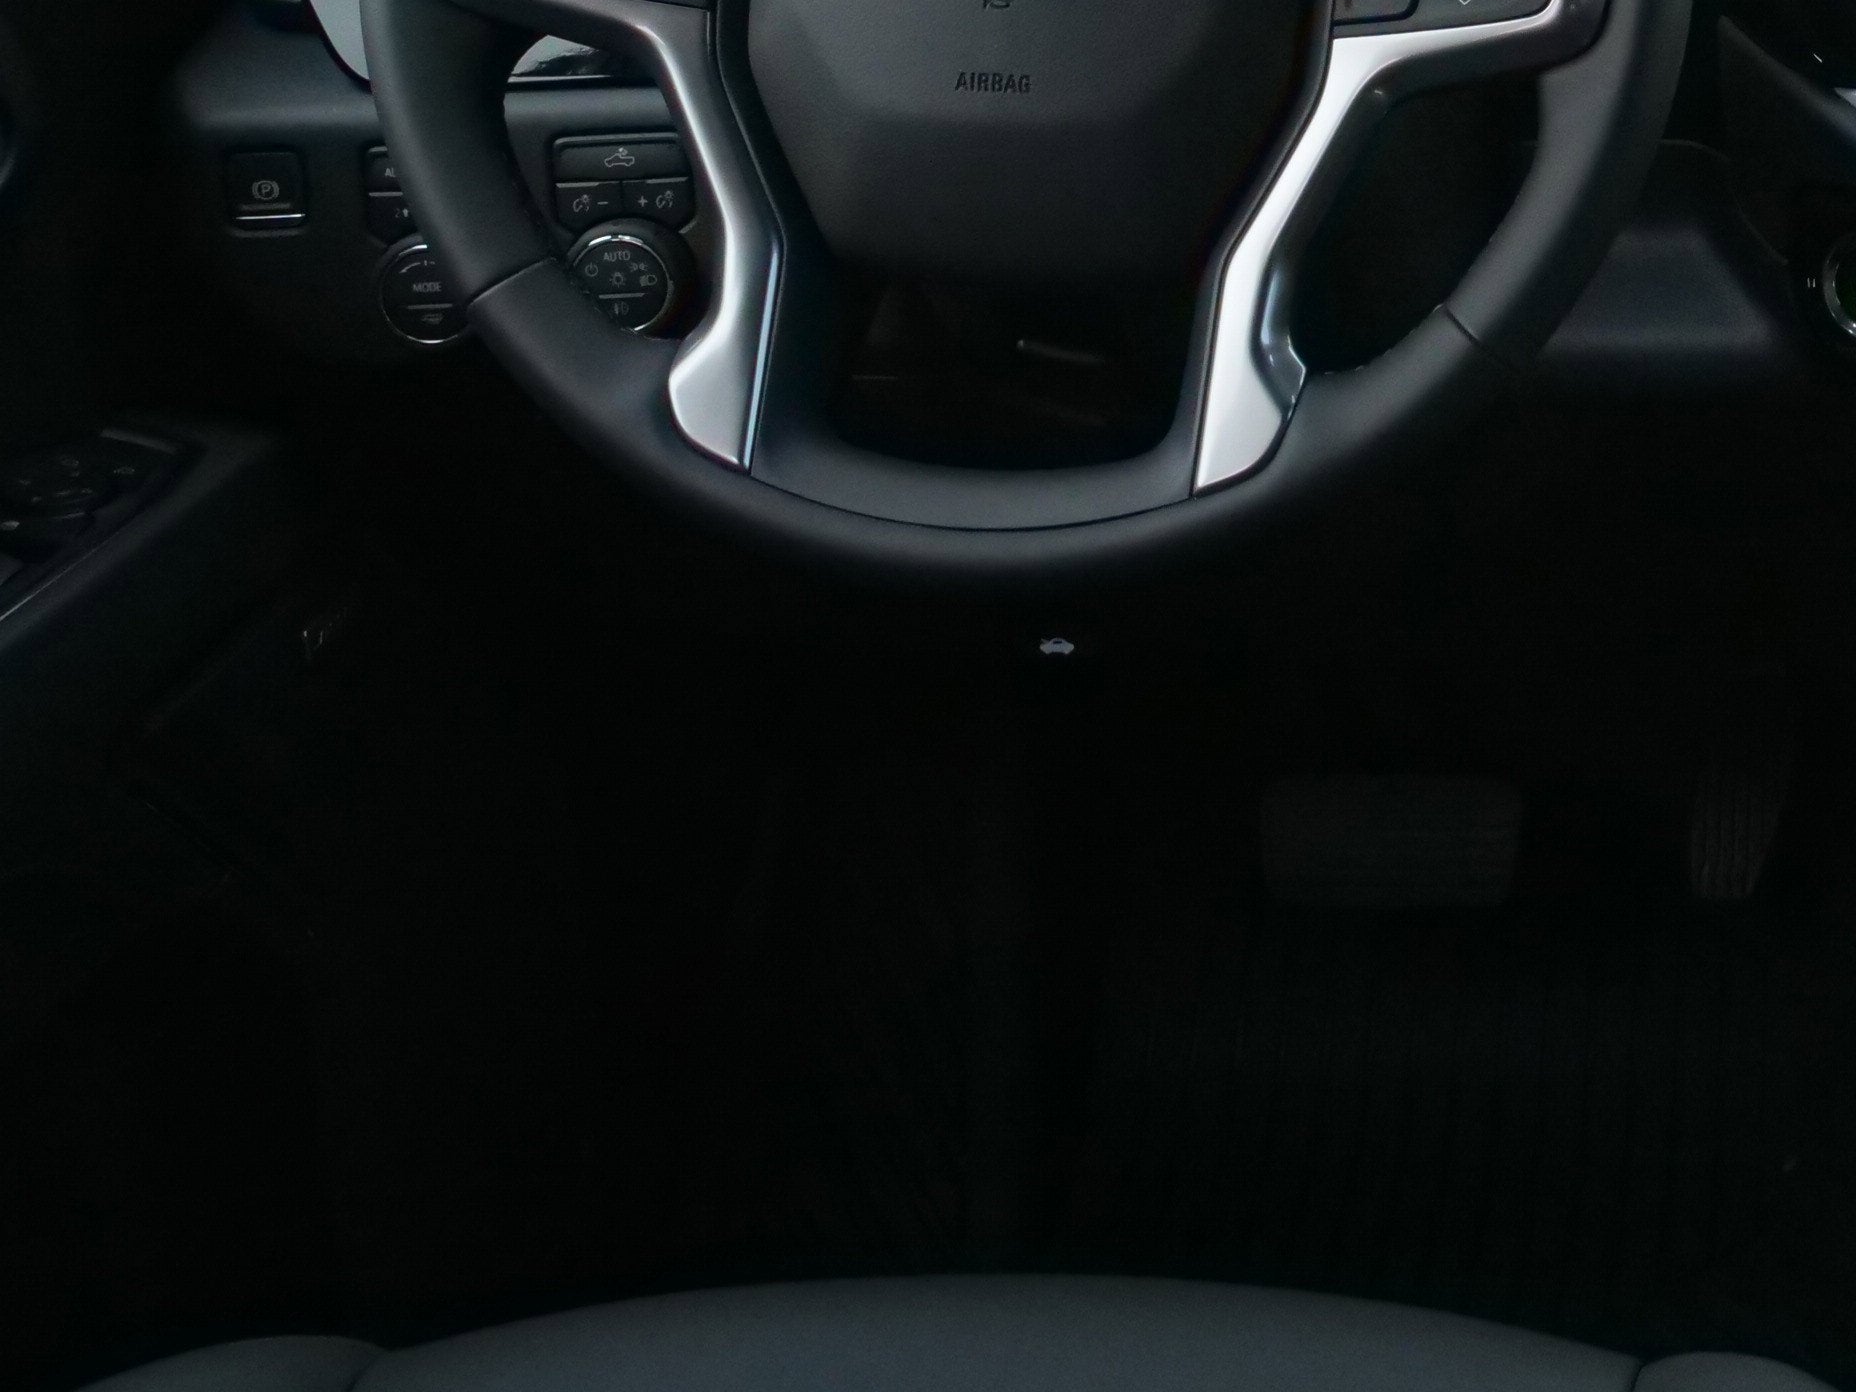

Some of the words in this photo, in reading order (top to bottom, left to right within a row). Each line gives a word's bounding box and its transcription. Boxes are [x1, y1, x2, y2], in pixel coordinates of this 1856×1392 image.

[954, 71, 1032, 94] AIRBAG
[603, 250, 631, 262] AUTO
[413, 281, 443, 293] MODE
